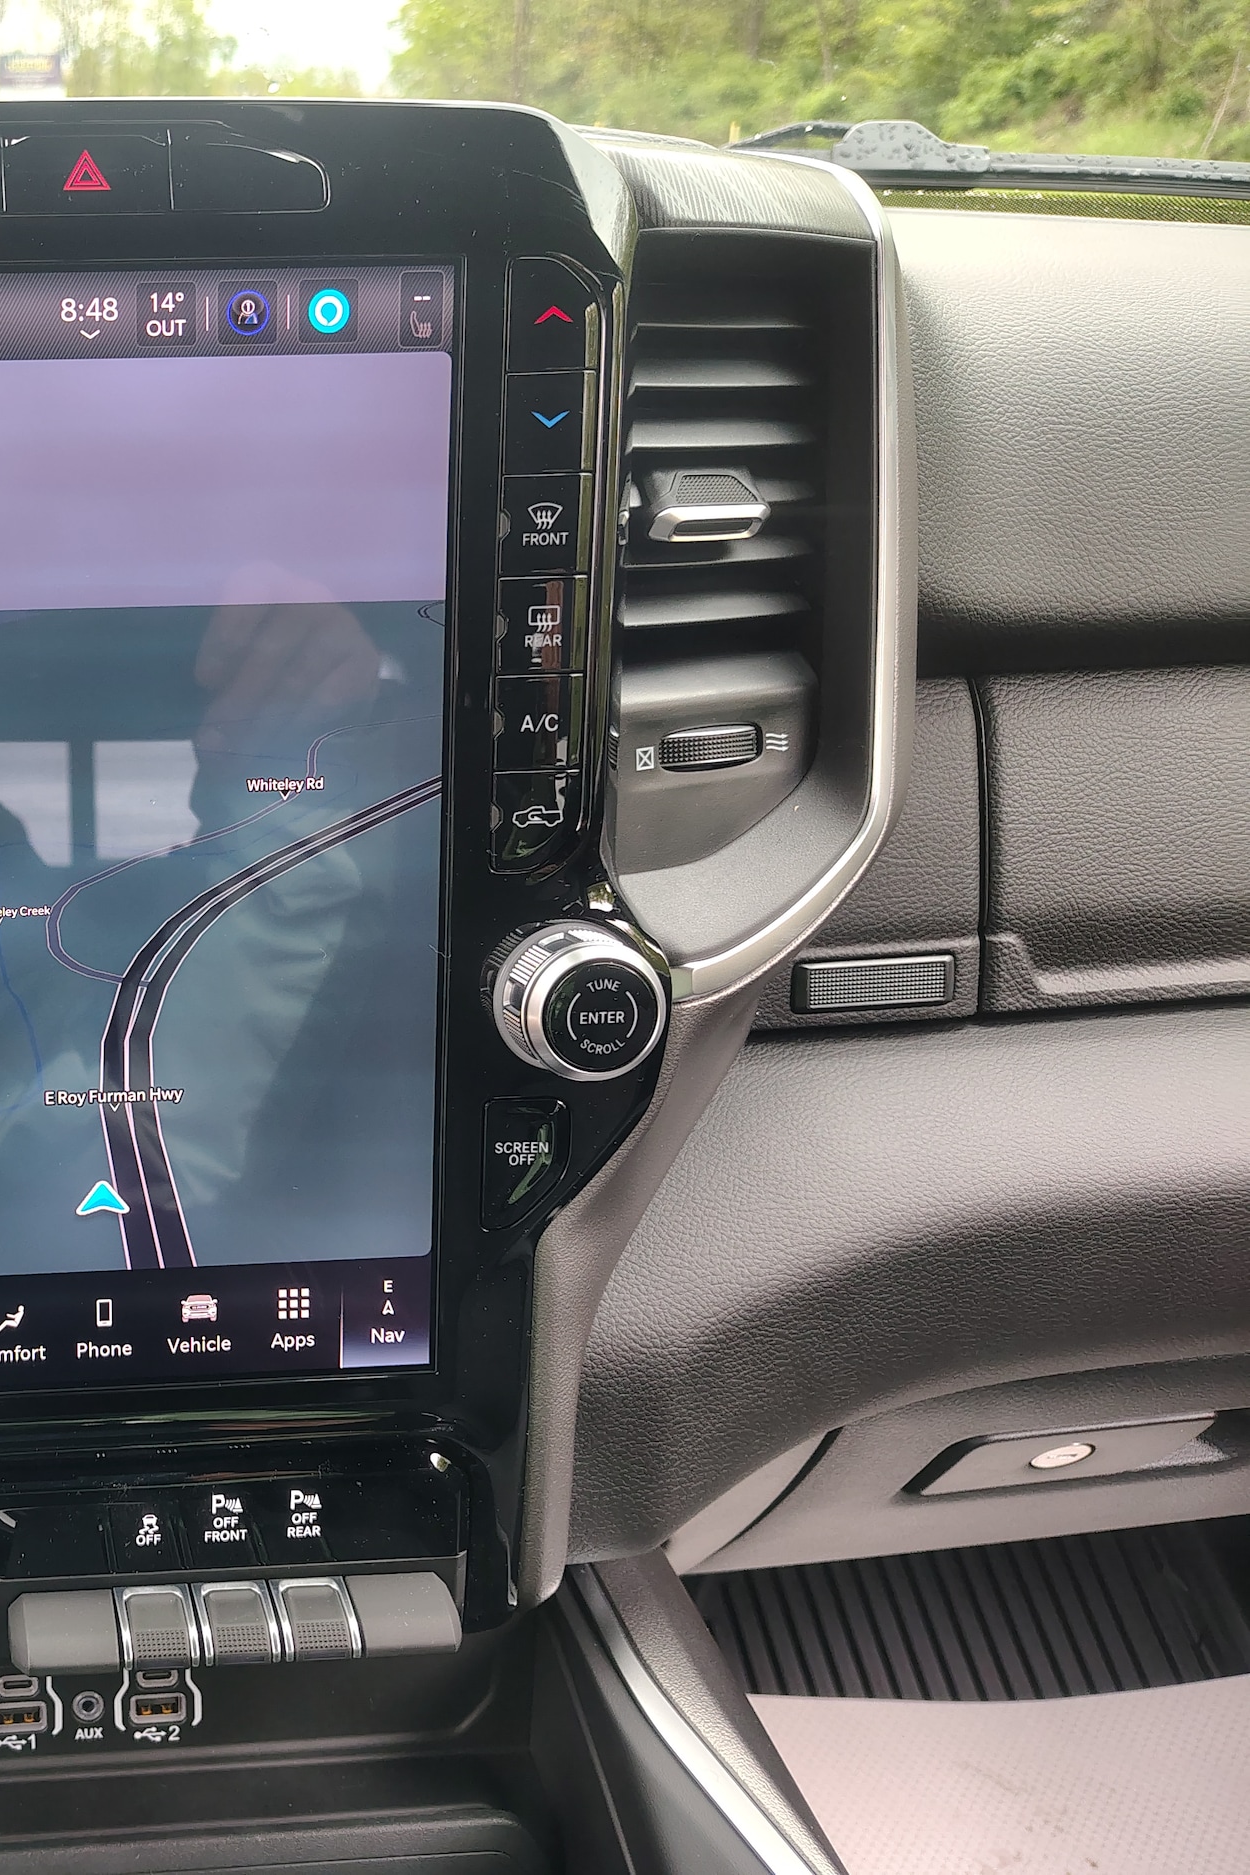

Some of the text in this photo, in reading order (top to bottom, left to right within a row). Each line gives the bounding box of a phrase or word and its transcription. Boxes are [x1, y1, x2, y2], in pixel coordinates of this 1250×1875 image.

[60, 297, 119, 322] 8:48
[149, 292, 185, 314] 14°
[145, 319, 187, 337] OUT
[522, 532, 568, 547] FRONT
[524, 635, 562, 648] REAR
[520, 714, 559, 733] A/C
[247, 777, 324, 793] Whiteley Rd
[19, 906, 51, 917] Creek
[586, 978, 621, 993] TUNE
[579, 1011, 625, 1025] ENTER
[579, 1039, 626, 1055] SCROLL
[45, 1087, 184, 1107] E Roy Furman Hwy
[495, 1142, 549, 1154] SCREEN
[508, 1153, 536, 1166] OFF
[383, 1280, 393, 1293] E
[271, 1333, 316, 1352] Apps
[371, 1328, 405, 1343] Nav
[76, 1342, 132, 1358] Phone
[167, 1335, 232, 1354] Vehicle
[213, 1516, 239, 1529] OFF
[291, 1511, 318, 1525] OFF
[204, 1528, 248, 1543] FRONT
[287, 1525, 322, 1539] REAR
[135, 1534, 162, 1547] OFF
[74, 1728, 103, 1740] AUX
[169, 1726, 181, 1742] 2
[28, 1734, 37, 1750] 1
